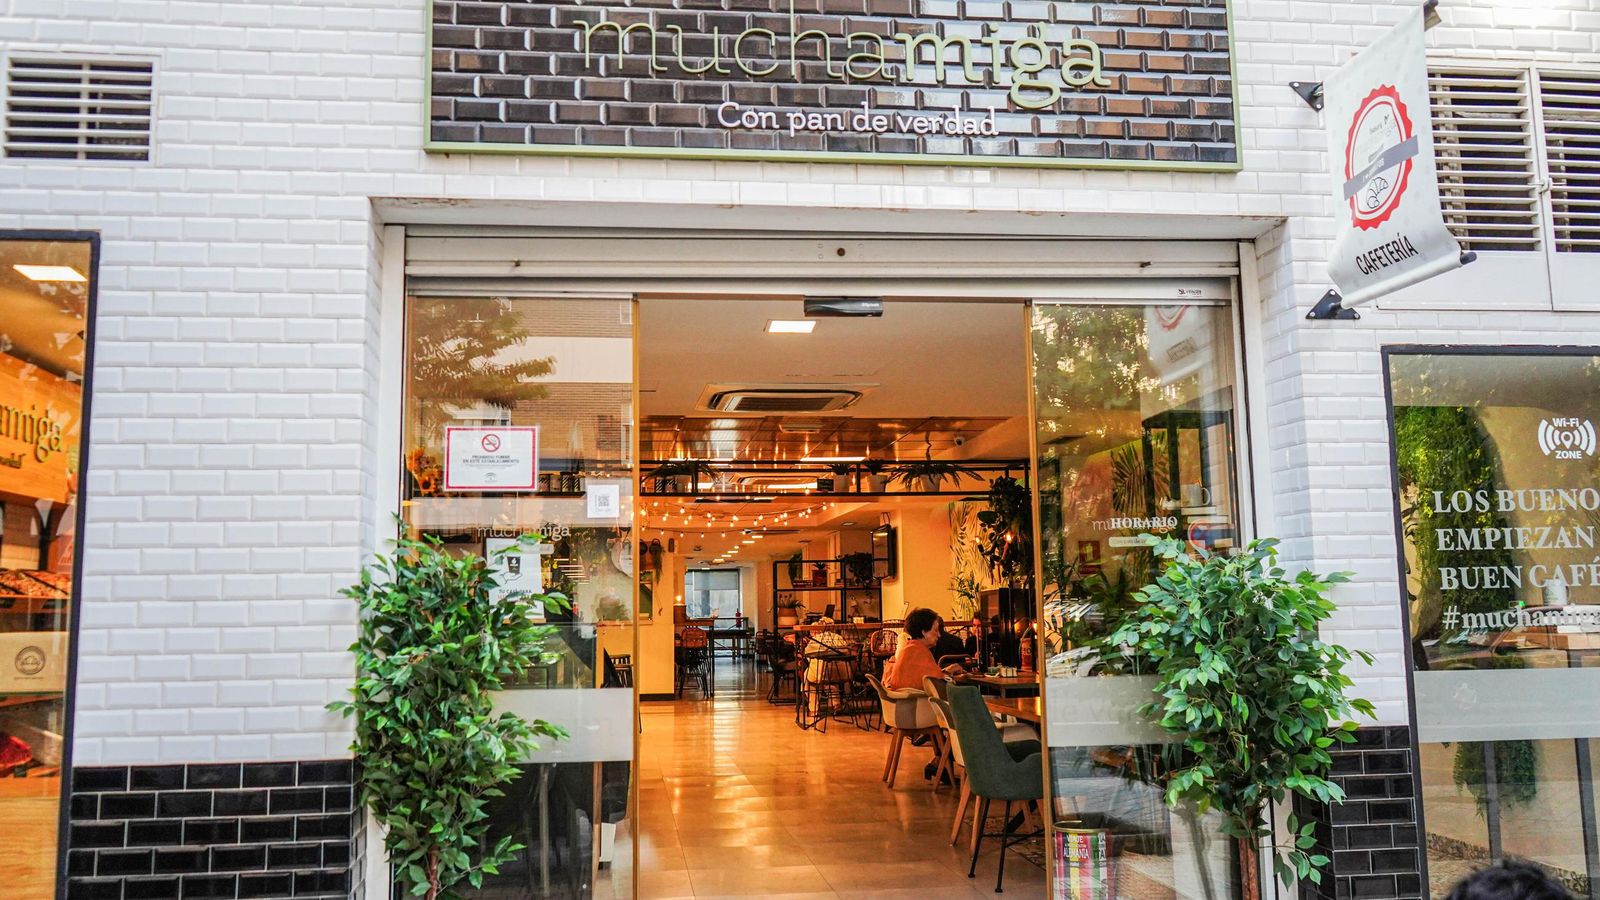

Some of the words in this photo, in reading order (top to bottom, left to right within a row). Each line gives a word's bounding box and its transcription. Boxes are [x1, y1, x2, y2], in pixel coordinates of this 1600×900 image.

[573, 0, 1112, 109] muchamiga
[717, 101, 780, 129] Con
[786, 110, 845, 137] pan
[852, 101, 889, 132] de
[896, 104, 1000, 136] verdad
[1356, 233, 1418, 275] CAFETERÍA
[1555, 450, 1582, 459] ZONE
[1432, 490, 1490, 513] LOS
[1110, 516, 1177, 529] HORARIO
[1435, 526, 1595, 551] EMPIEZAN
[1438, 566, 1522, 590] BUEN
[1528, 555, 1600, 588] CAFÉ
